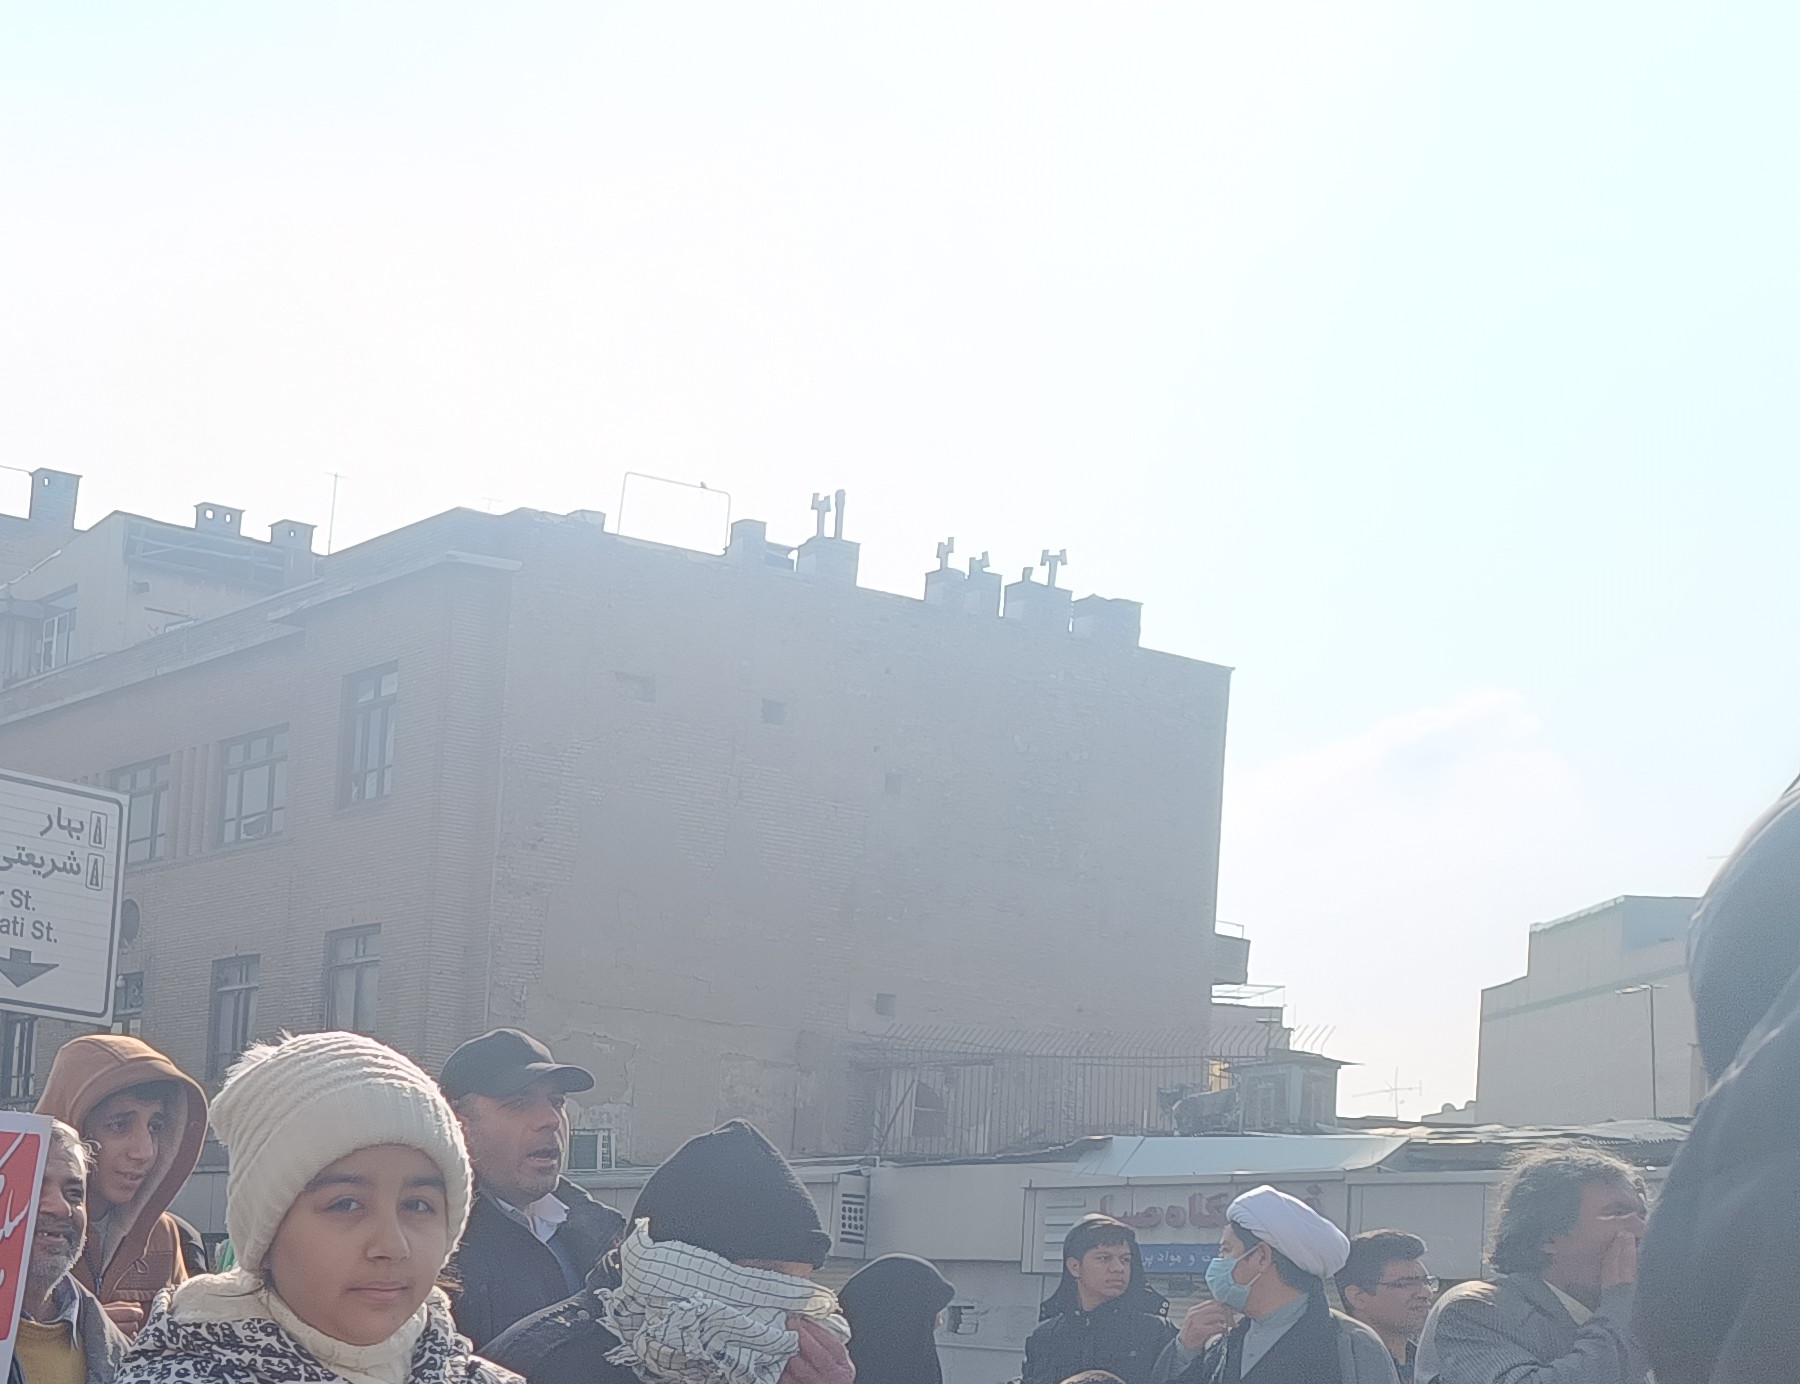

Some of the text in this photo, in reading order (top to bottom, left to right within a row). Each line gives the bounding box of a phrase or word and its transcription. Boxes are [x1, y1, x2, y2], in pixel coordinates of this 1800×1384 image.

[39, 807, 85, 841] بهار
[10, 888, 36, 912] St.
[30, 920, 58, 944] St.
